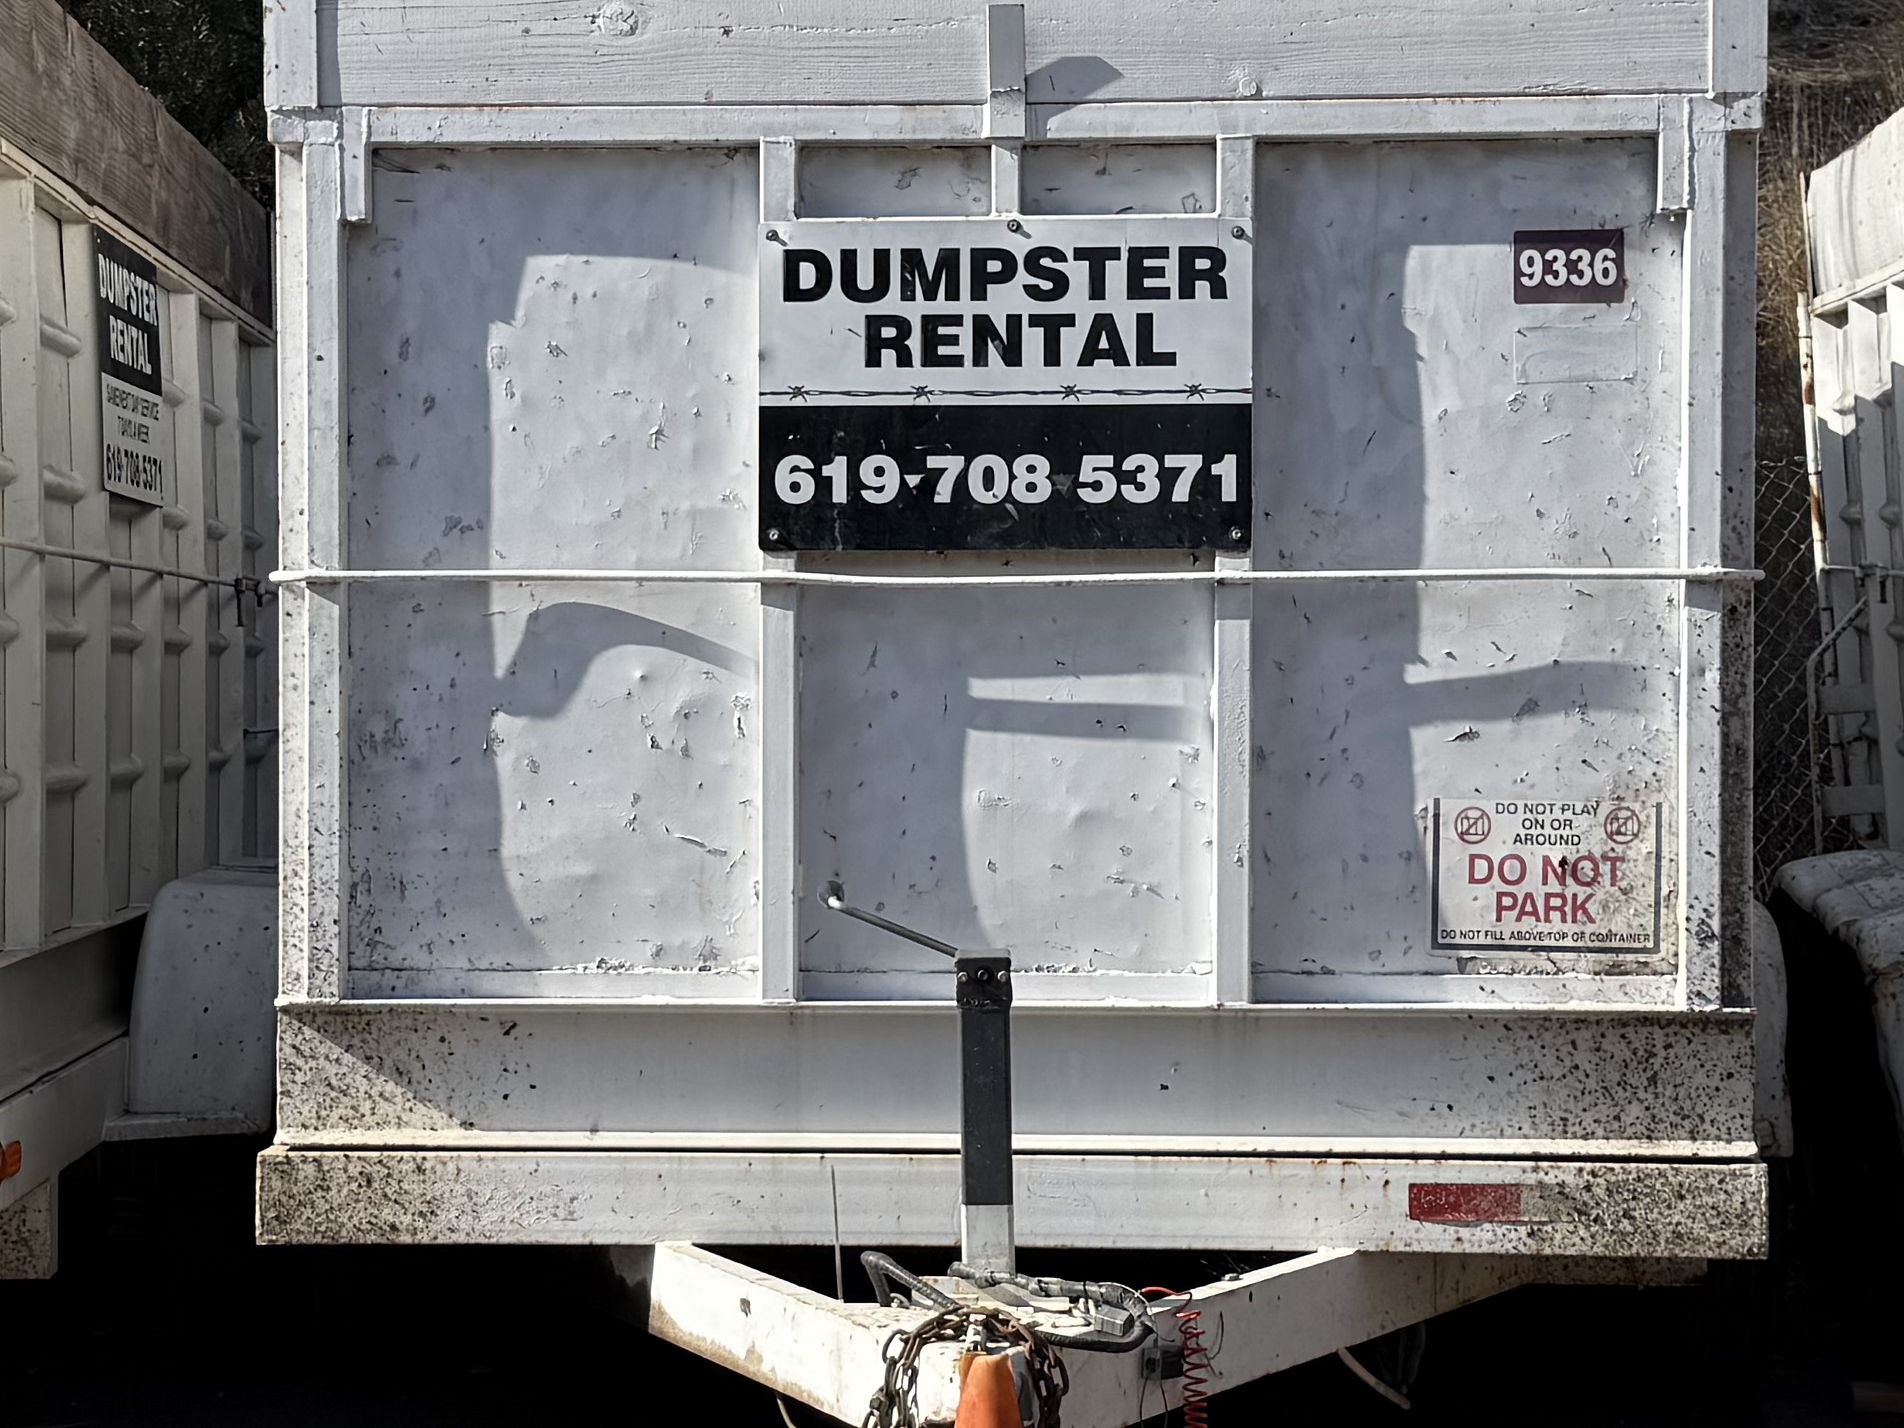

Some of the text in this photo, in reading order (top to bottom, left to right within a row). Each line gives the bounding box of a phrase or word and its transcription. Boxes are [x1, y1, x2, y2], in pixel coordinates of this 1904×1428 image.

[783, 246, 1228, 303] DUMPSTER
[1519, 248, 1617, 287] 9336
[98, 253, 158, 326] DUMPSTER
[109, 314, 152, 375] RENTAL
[865, 313, 1177, 368] RENTAL
[1076, 453, 1238, 504] 5371
[1496, 802, 1600, 816] DO NOT PLAY
[1522, 818, 1573, 830] ON OR
[1513, 833, 1581, 846] AROUND
[1468, 854, 1625, 888] DO NOT
[1496, 892, 1596, 924] PARK
[1441, 929, 1650, 944] DO NOT FILL ABOVE TOP OF CONTAINER
